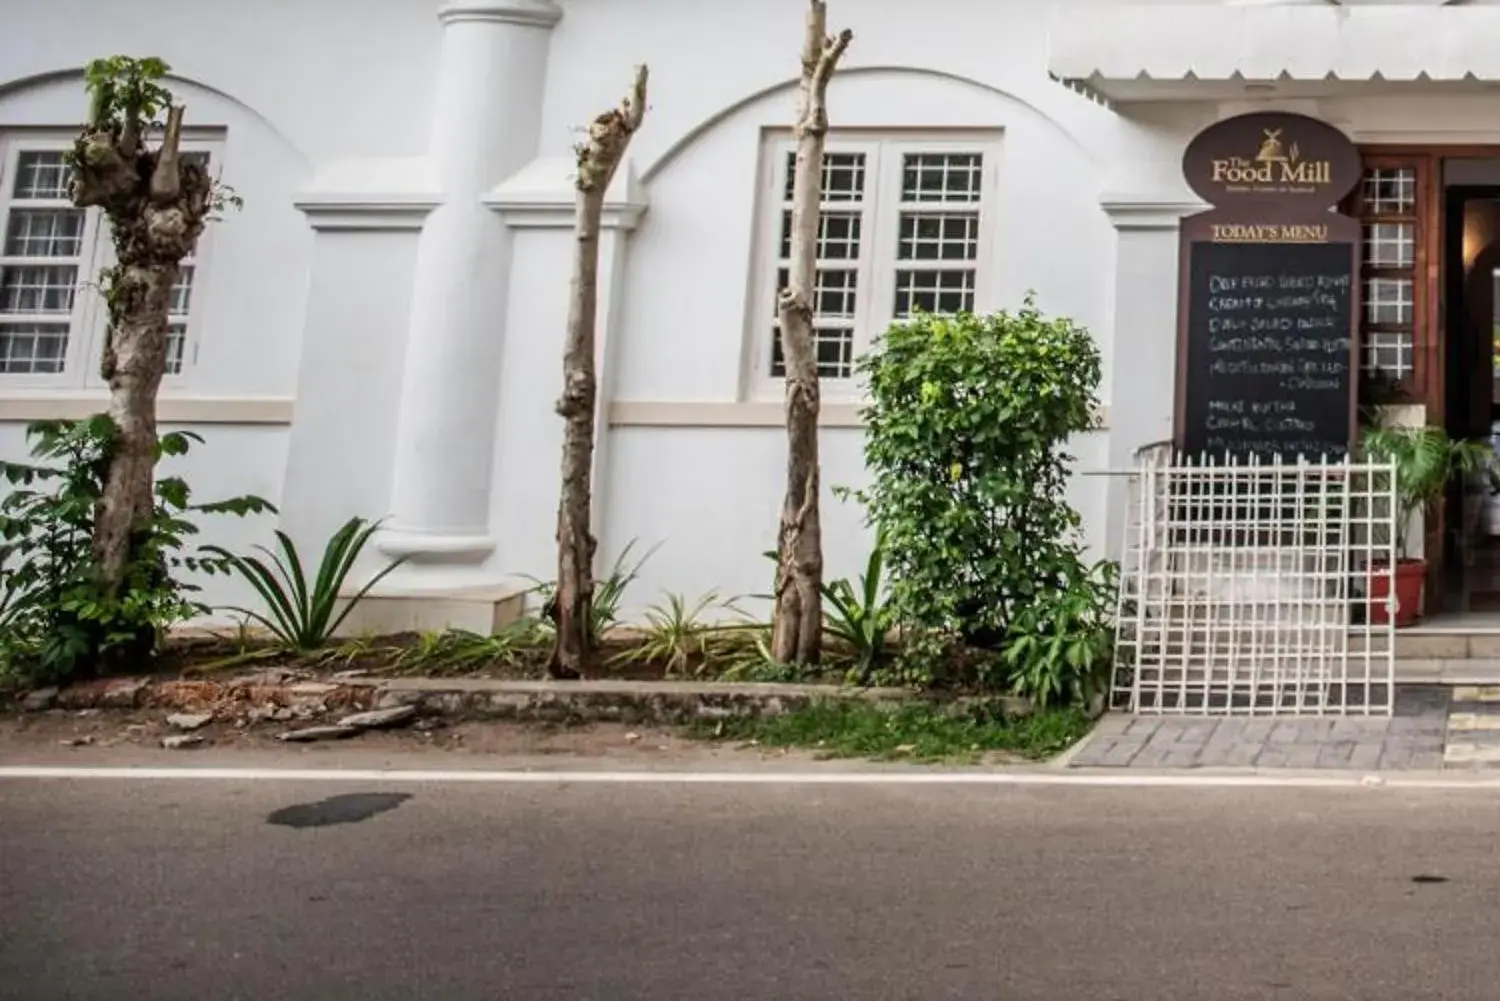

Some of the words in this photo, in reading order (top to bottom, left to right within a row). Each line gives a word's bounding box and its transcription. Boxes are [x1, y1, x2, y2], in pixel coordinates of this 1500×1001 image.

[1211, 159, 1273, 182] Food
[1279, 161, 1331, 183] Mill
[1211, 224, 1279, 239] TODAY'S
[1281, 225, 1328, 240] MENU
